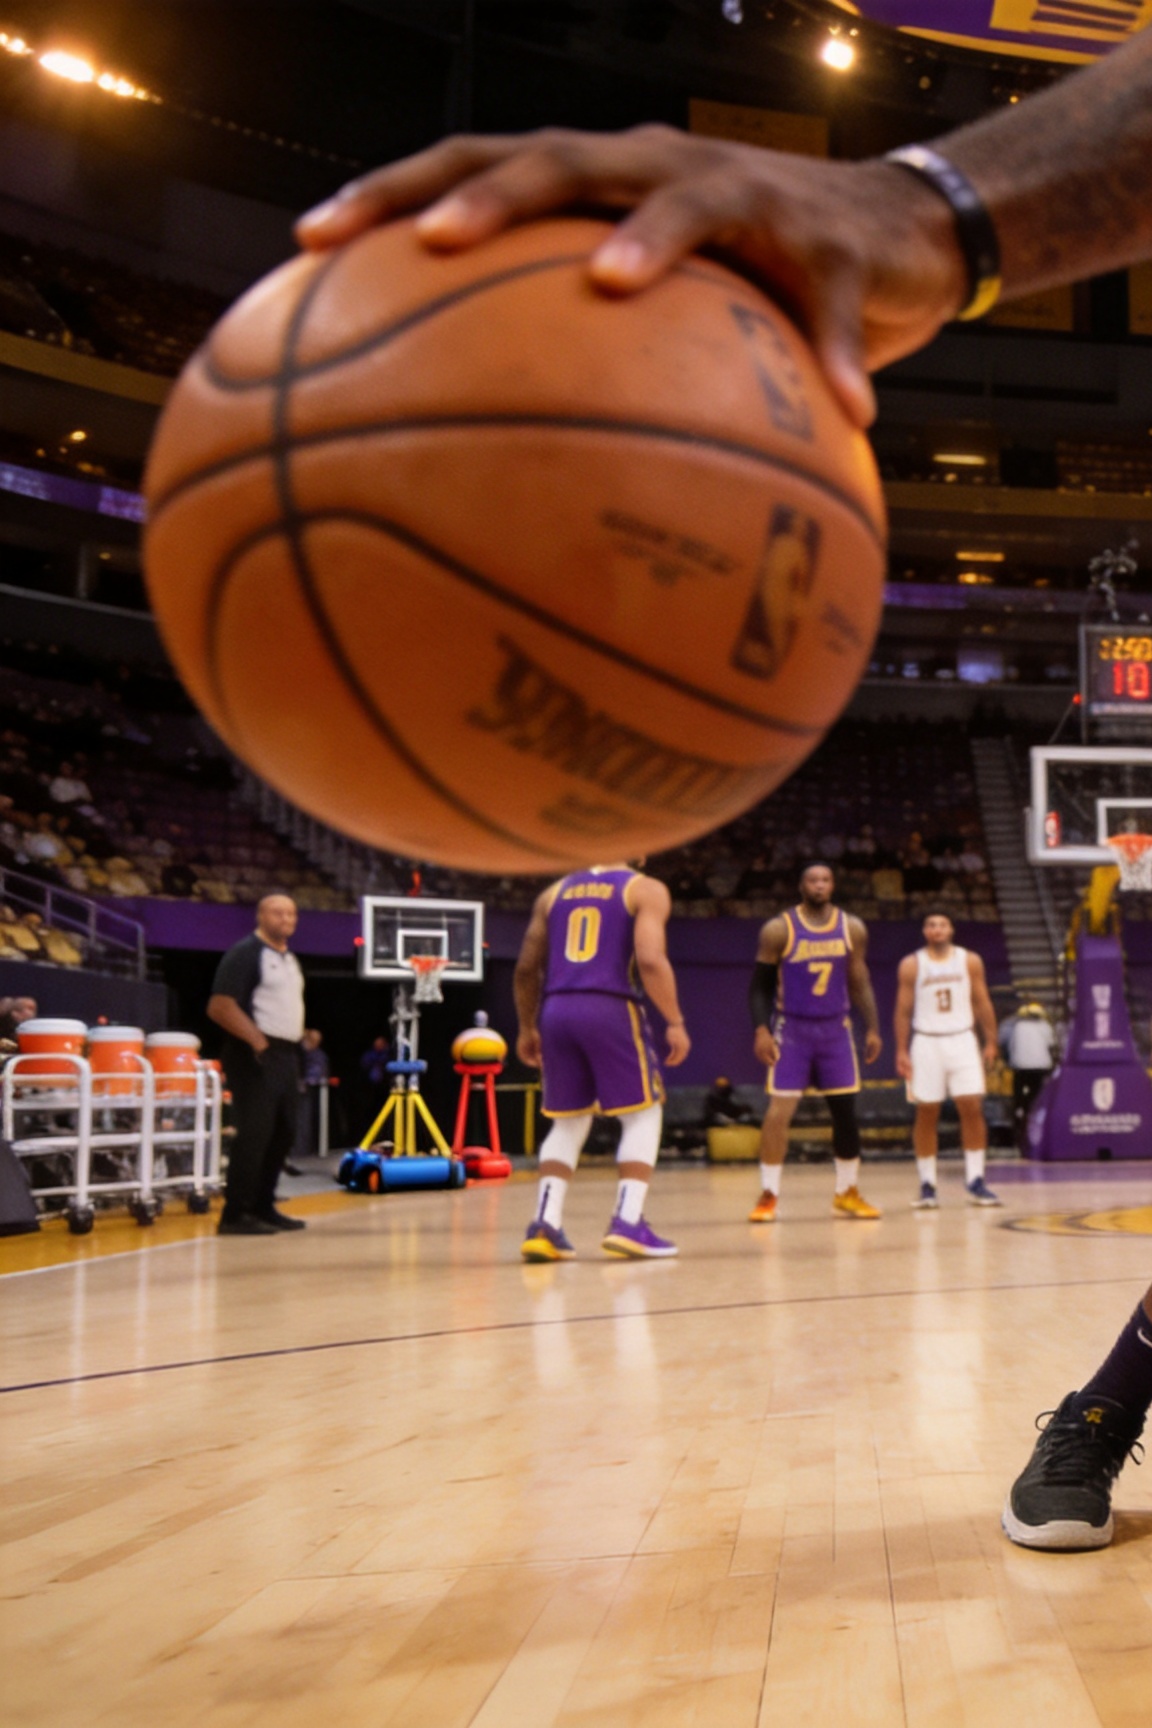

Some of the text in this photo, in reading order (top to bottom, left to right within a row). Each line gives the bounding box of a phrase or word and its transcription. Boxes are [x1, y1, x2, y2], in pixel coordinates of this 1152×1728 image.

[1113, 661, 1150, 699] 10
[565, 906, 602, 963] 0
[808, 962, 833, 996] 7
